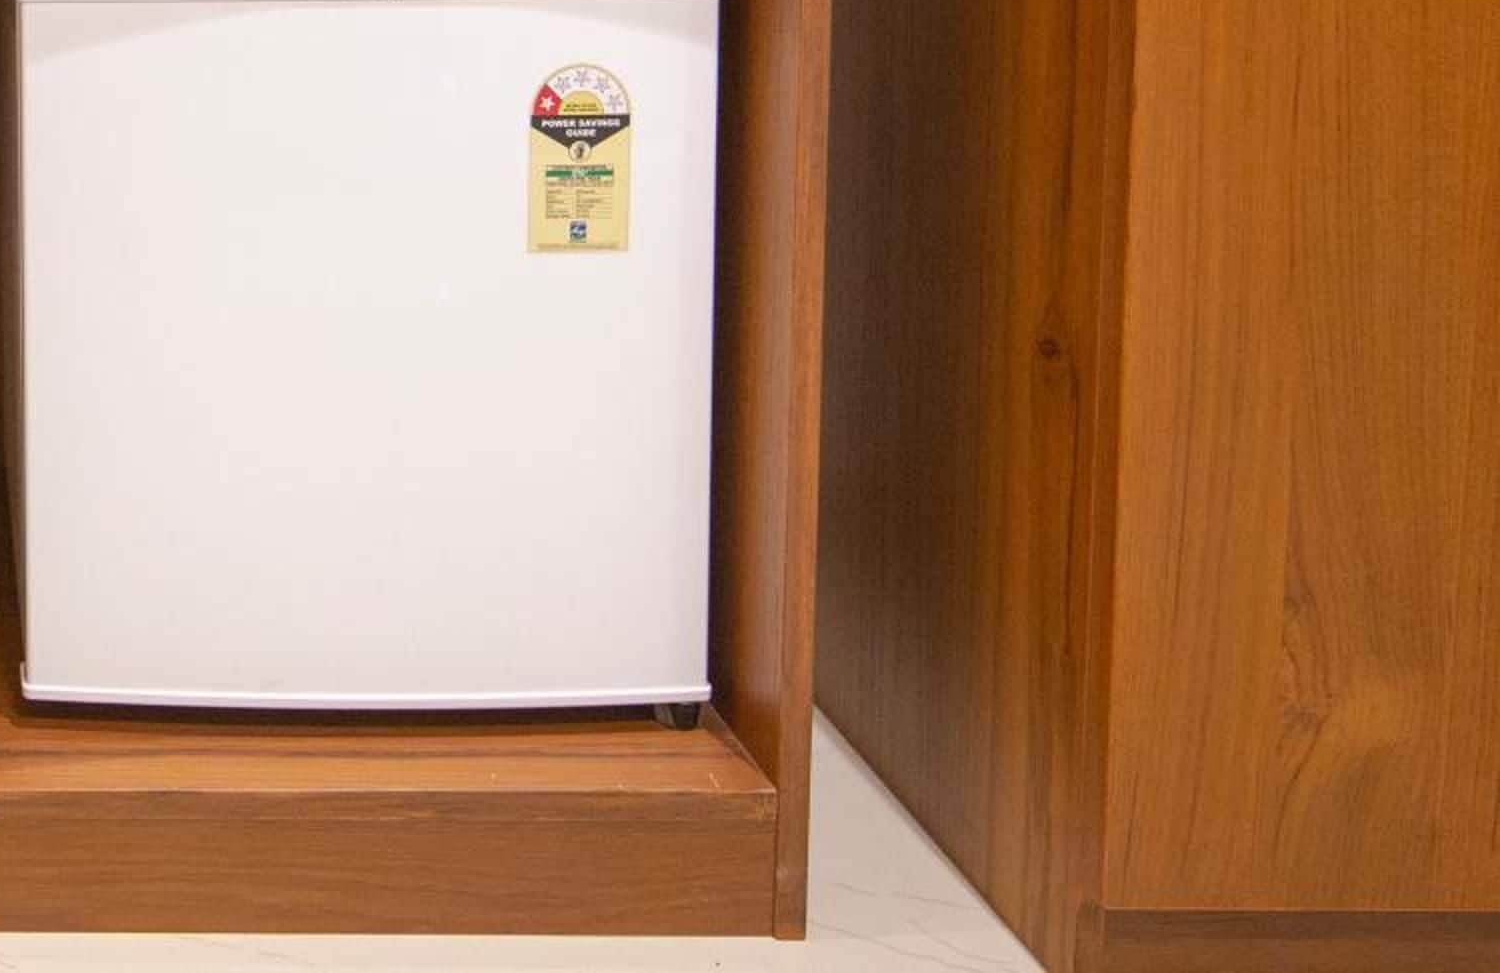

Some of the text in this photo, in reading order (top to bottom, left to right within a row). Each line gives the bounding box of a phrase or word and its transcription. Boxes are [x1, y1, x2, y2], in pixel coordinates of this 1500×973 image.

[541, 118, 621, 128] POWER SAVINGS
[565, 129, 597, 138] GUIDE
